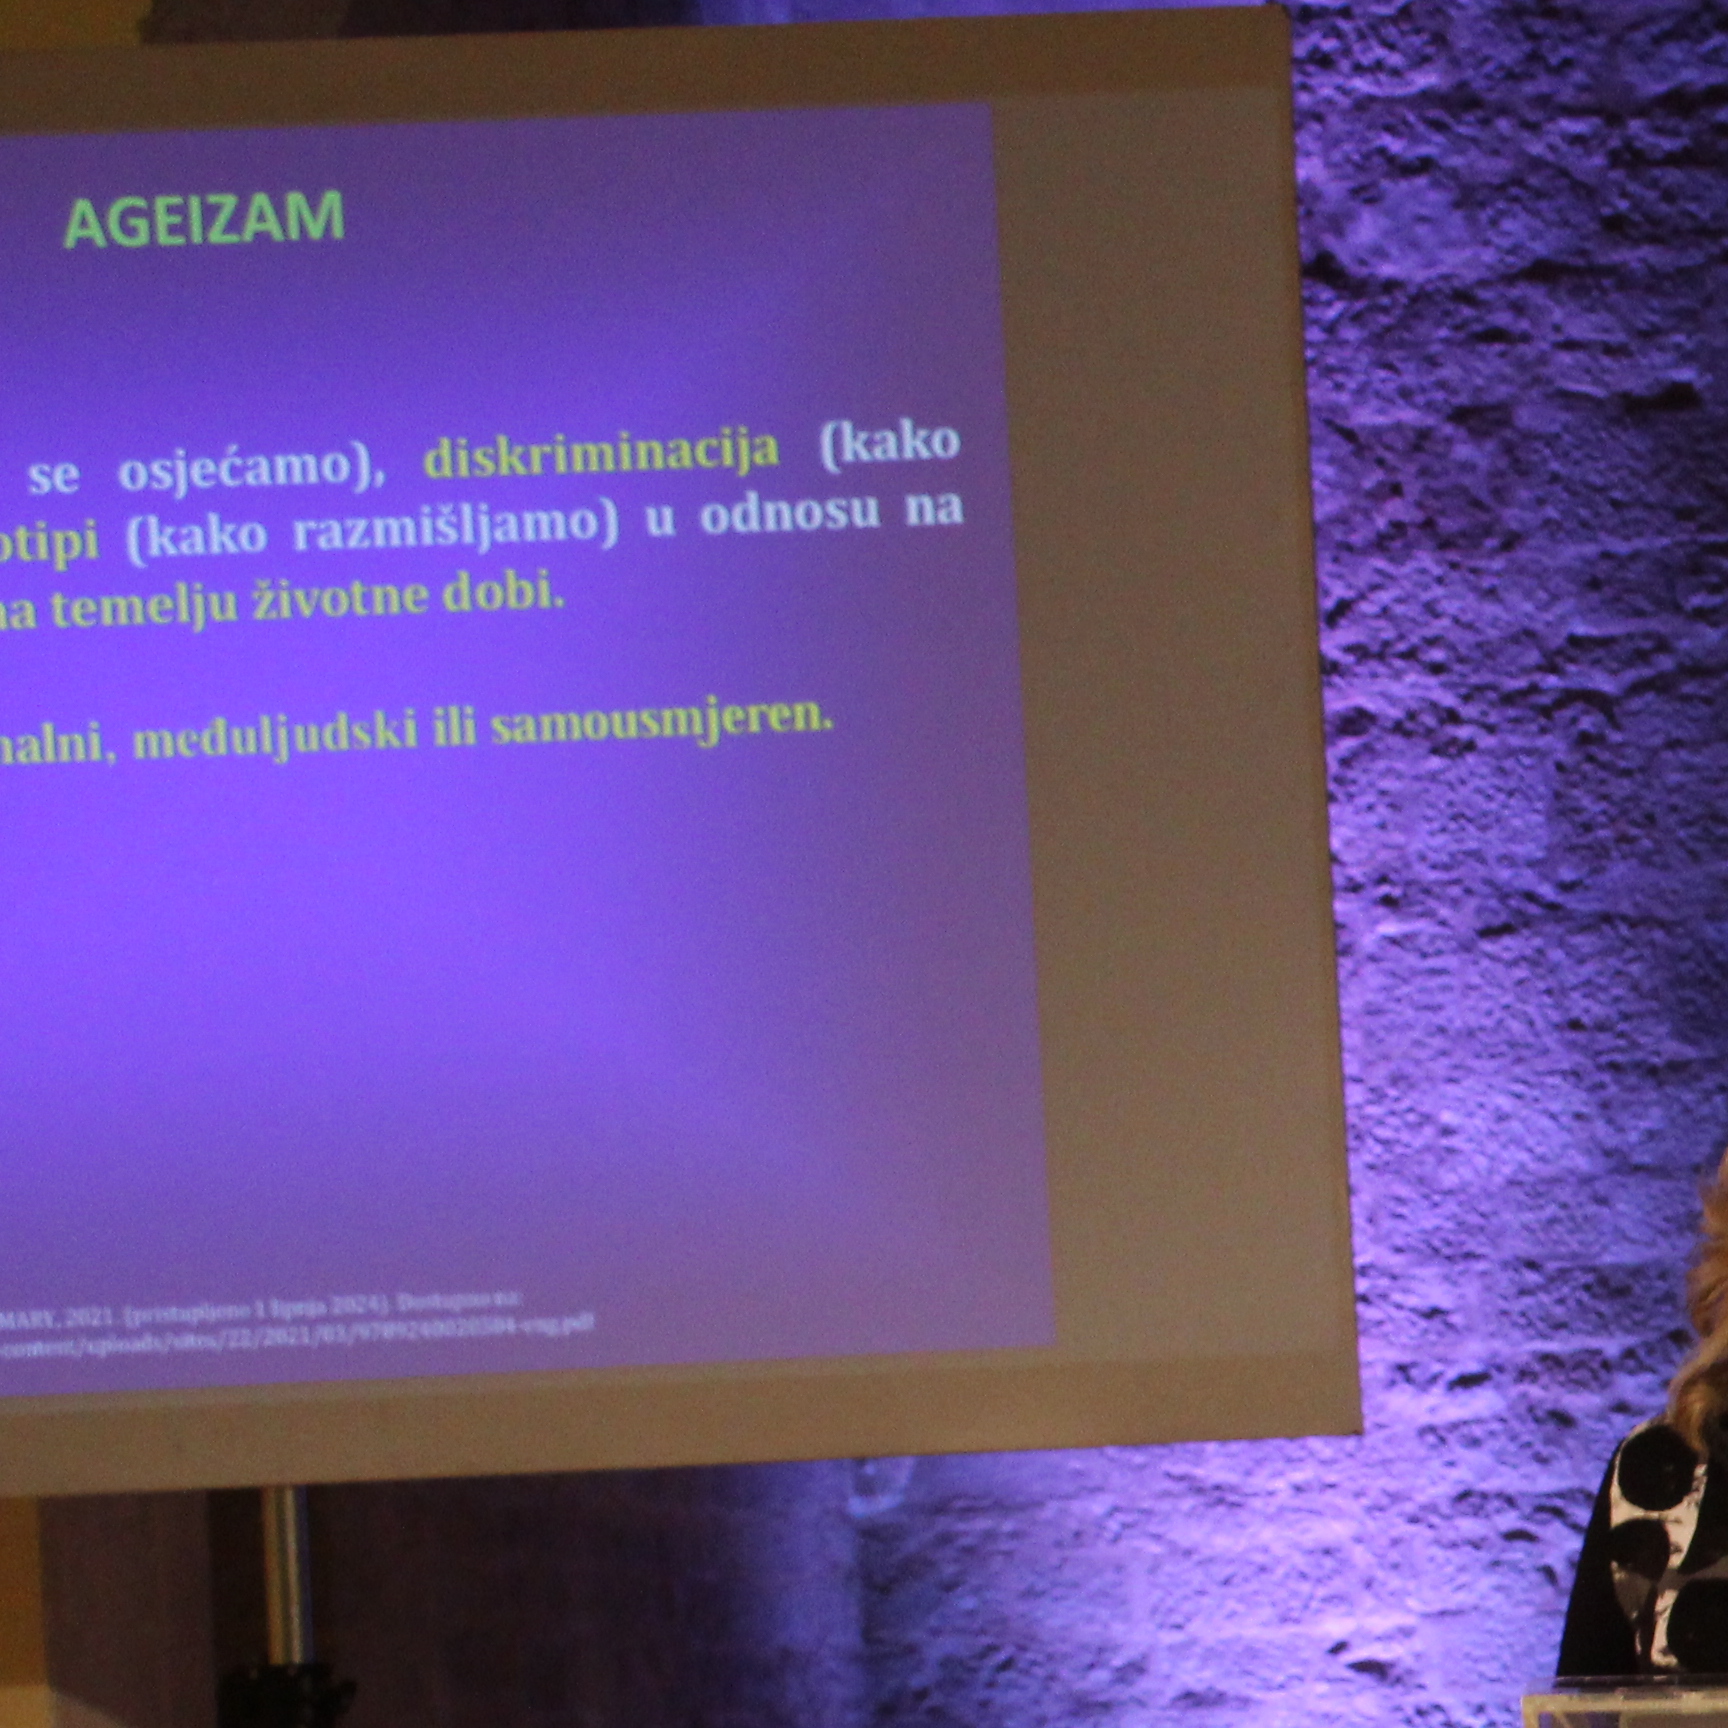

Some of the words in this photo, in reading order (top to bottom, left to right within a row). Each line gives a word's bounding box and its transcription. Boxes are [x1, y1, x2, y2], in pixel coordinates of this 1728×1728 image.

[63, 189, 345, 250] AGEIZAM
[28, 460, 81, 494] se
[119, 440, 385, 499] osjećamo),
[423, 426, 779, 478] diskriminacija
[820, 417, 961, 474] (kako
[126, 512, 268, 567] (kako
[293, 496, 619, 555] razmišljamo)
[646, 505, 676, 536] u
[700, 490, 880, 534] odnosu
[905, 491, 964, 526] na
[50, 581, 239, 634] temelju
[251, 577, 429, 621] životne
[442, 568, 565, 612] dobi.
[432, 705, 478, 747] ili
[490, 694, 833, 748] samousmjeren.
